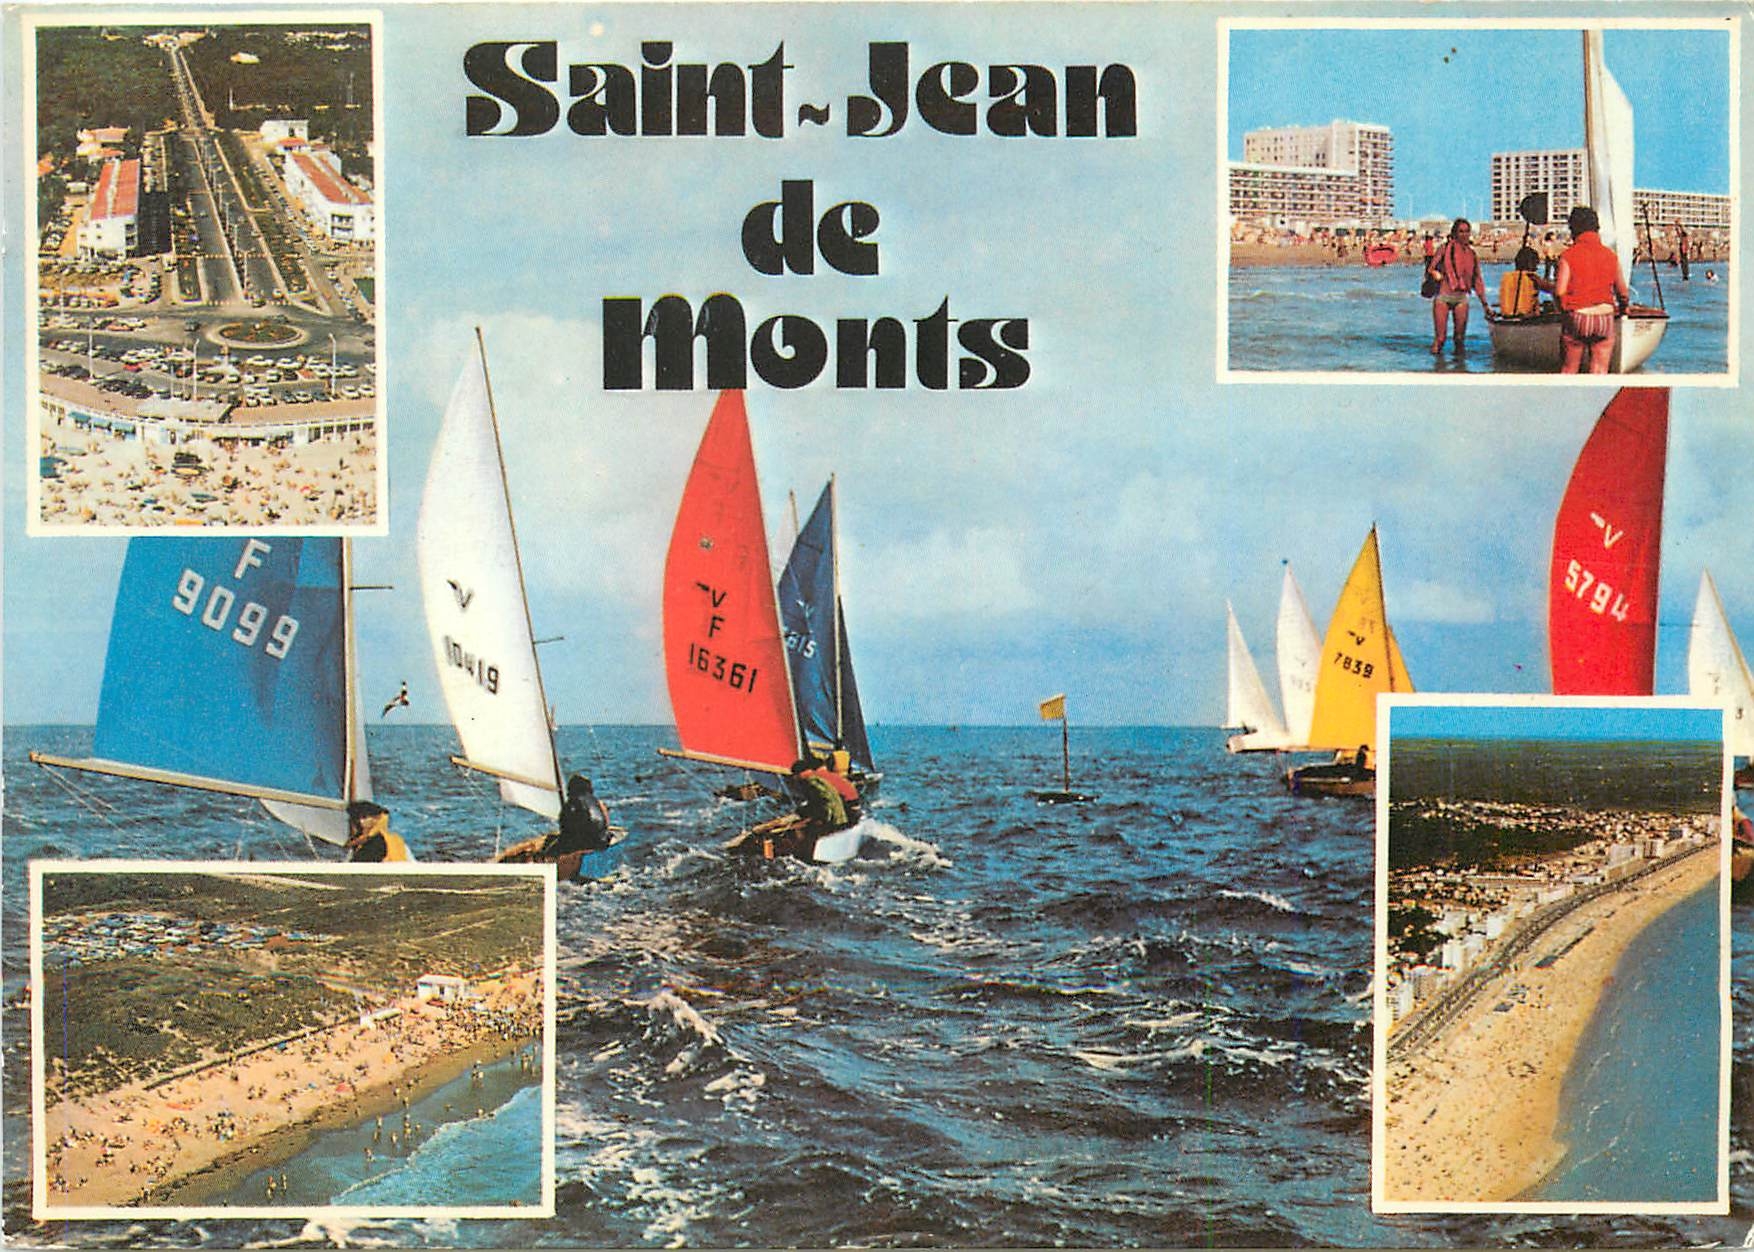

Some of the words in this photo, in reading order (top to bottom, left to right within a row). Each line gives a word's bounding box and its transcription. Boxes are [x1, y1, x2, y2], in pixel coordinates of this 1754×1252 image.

[234, 538, 272, 580] F
[1565, 559, 1630, 622] 5794
[172, 568, 300, 660] 9099
[709, 615, 726, 638] F
[688, 643, 758, 693] 16361
[1334, 652, 1374, 679] 7839
